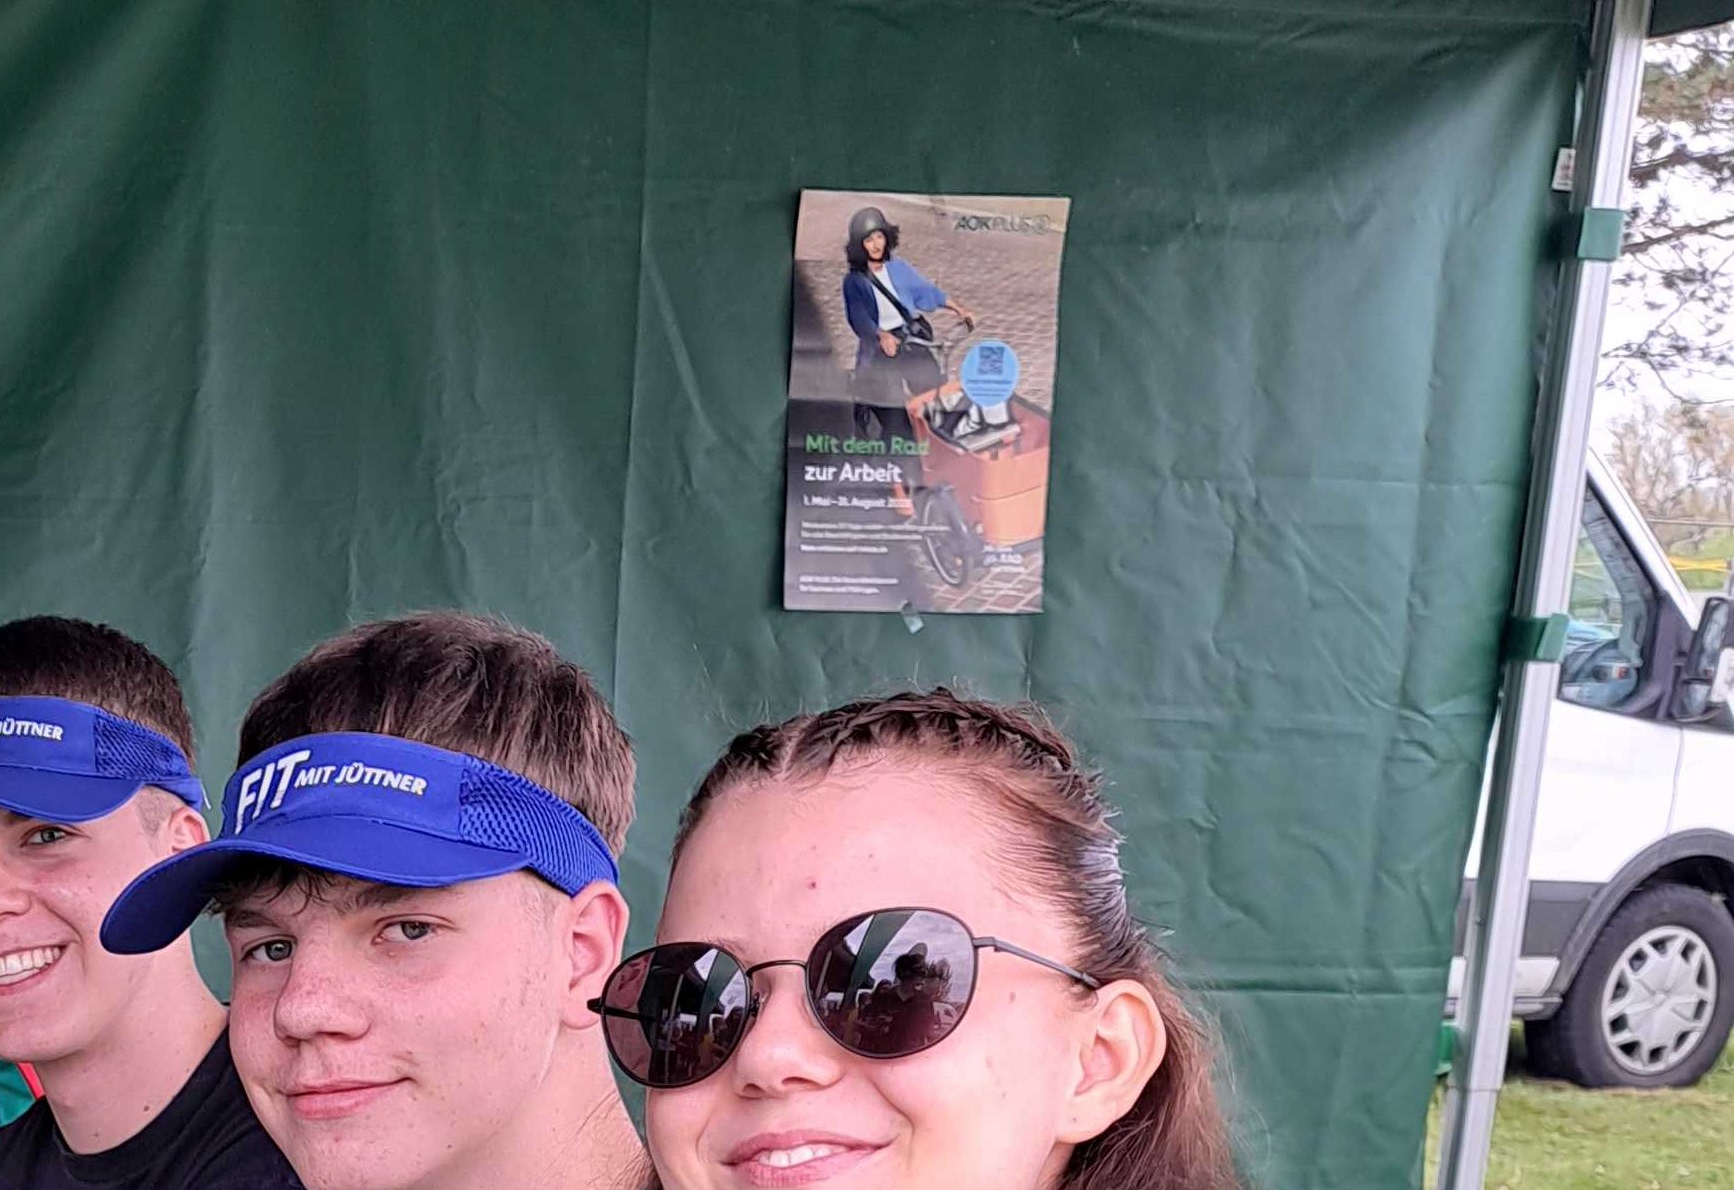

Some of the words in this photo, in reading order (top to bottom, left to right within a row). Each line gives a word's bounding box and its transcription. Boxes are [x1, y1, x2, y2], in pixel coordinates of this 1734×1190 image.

[805, 433, 839, 455] Mit
[842, 435, 886, 455] dem
[890, 435, 930, 456] Rad
[804, 464, 838, 482] zur
[839, 461, 903, 483] Arbeit
[234, 749, 311, 836] FIT
[294, 764, 332, 789] MIT
[333, 761, 428, 797] JÜTTNER
